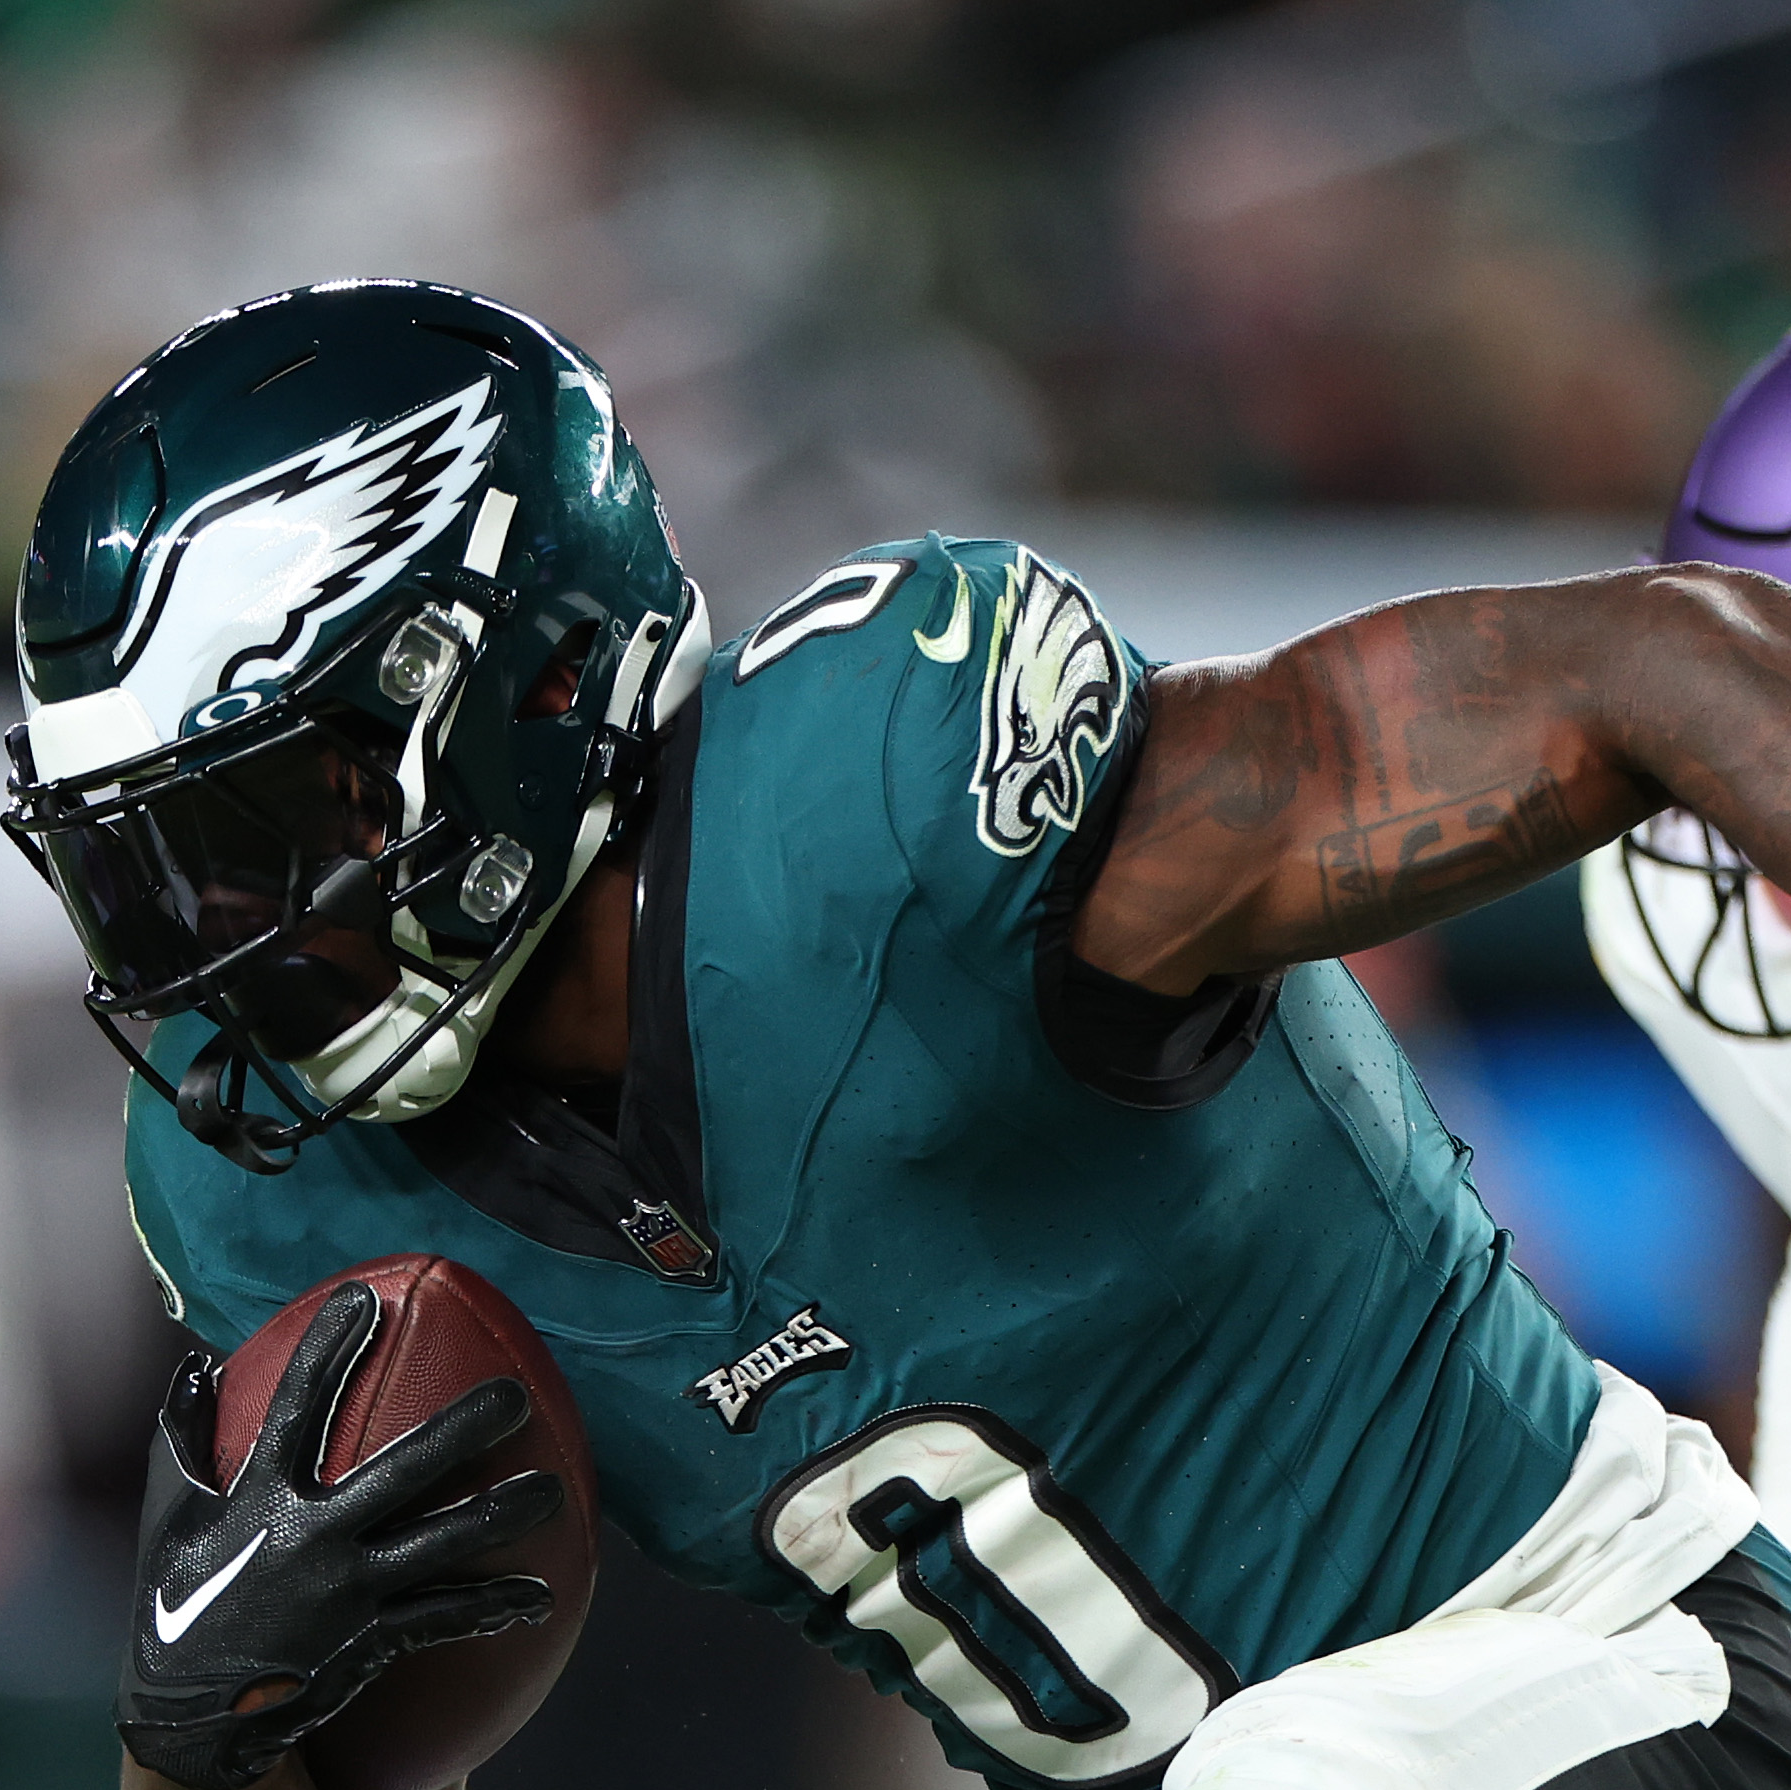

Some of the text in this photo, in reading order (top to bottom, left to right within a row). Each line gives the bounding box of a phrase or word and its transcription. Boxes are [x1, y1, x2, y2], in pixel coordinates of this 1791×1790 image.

[733, 558, 917, 687] 0
[647, 1233, 704, 1269] NFL
[694, 1306, 851, 1427] EAGLES
[755, 1403, 1238, 1790] 0
